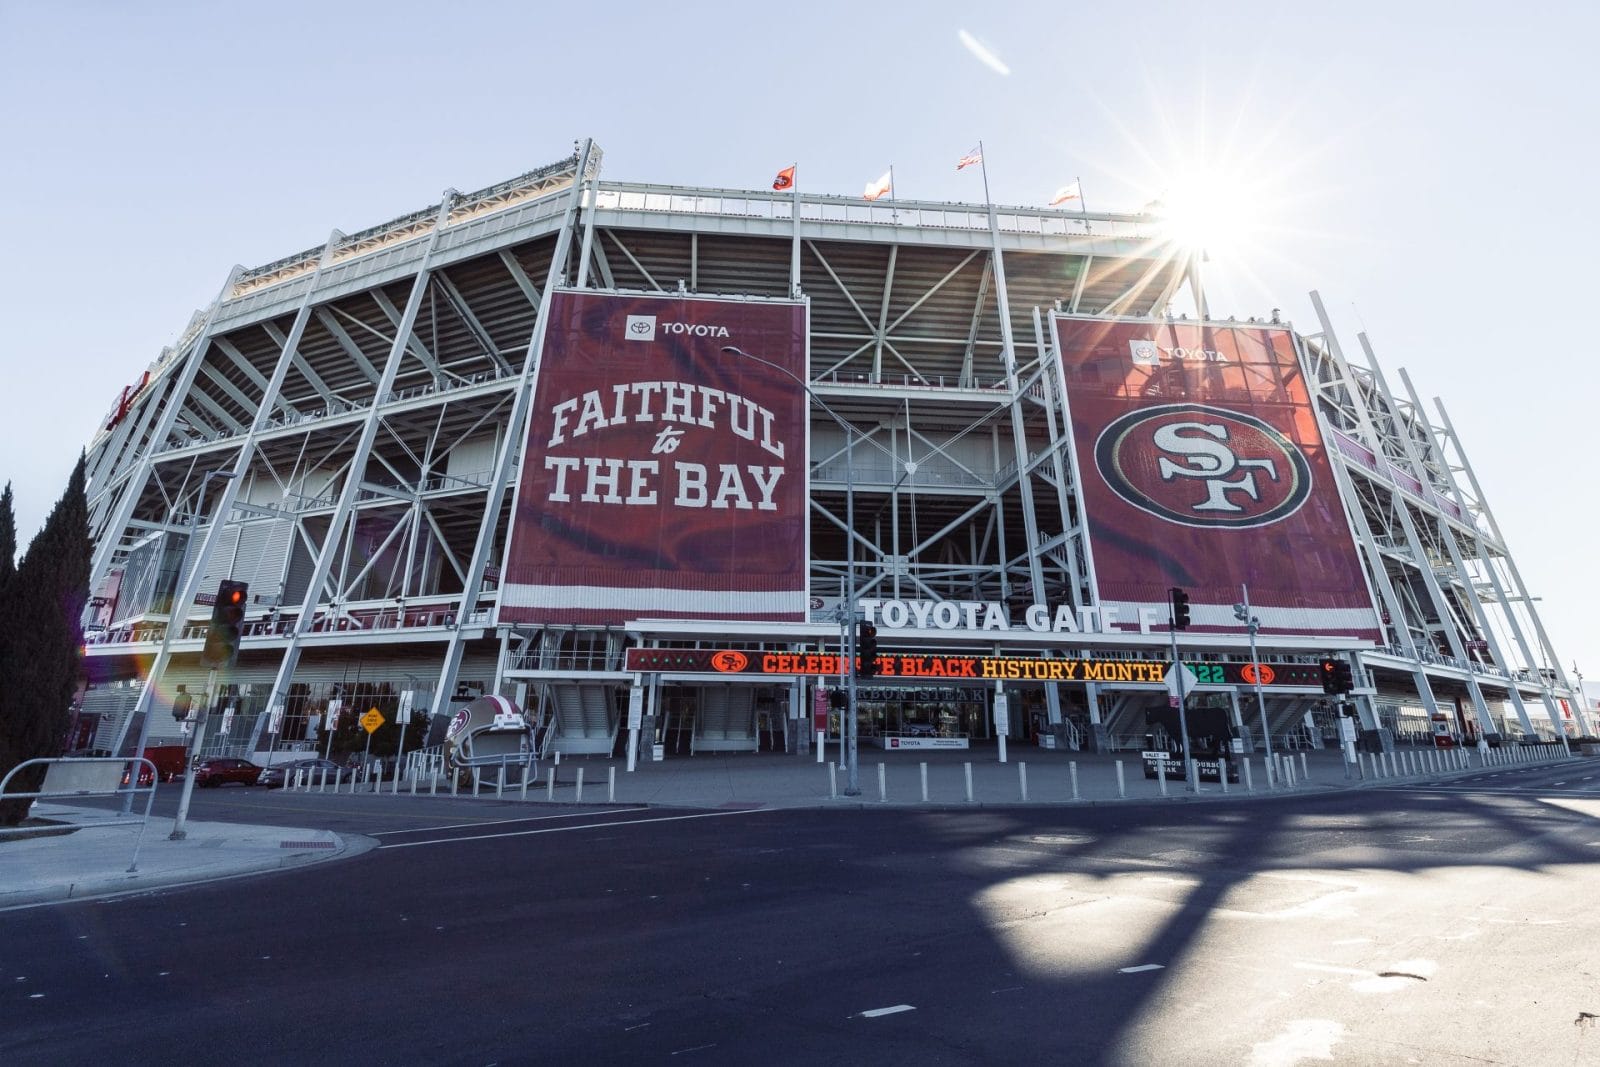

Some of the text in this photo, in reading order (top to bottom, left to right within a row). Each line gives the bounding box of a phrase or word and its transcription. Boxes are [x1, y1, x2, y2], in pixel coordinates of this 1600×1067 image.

[661, 322, 730, 338] TOYOTA
[1164, 347, 1228, 362] TOYOTA
[547, 381, 785, 460] FAITHFUL
[651, 425, 685, 454] to
[1153, 422, 1280, 512] SF
[545, 456, 785, 511] THE BAY
[859, 600, 1157, 635] TOYOTA GATE F
[763, 655, 895, 676] CELEBRE
[901, 657, 977, 678] BLACK
[981, 659, 1077, 681] HISTORY
[1083, 662, 1164, 682] MONTH
[857, 690, 984, 701] RBON STEAK
